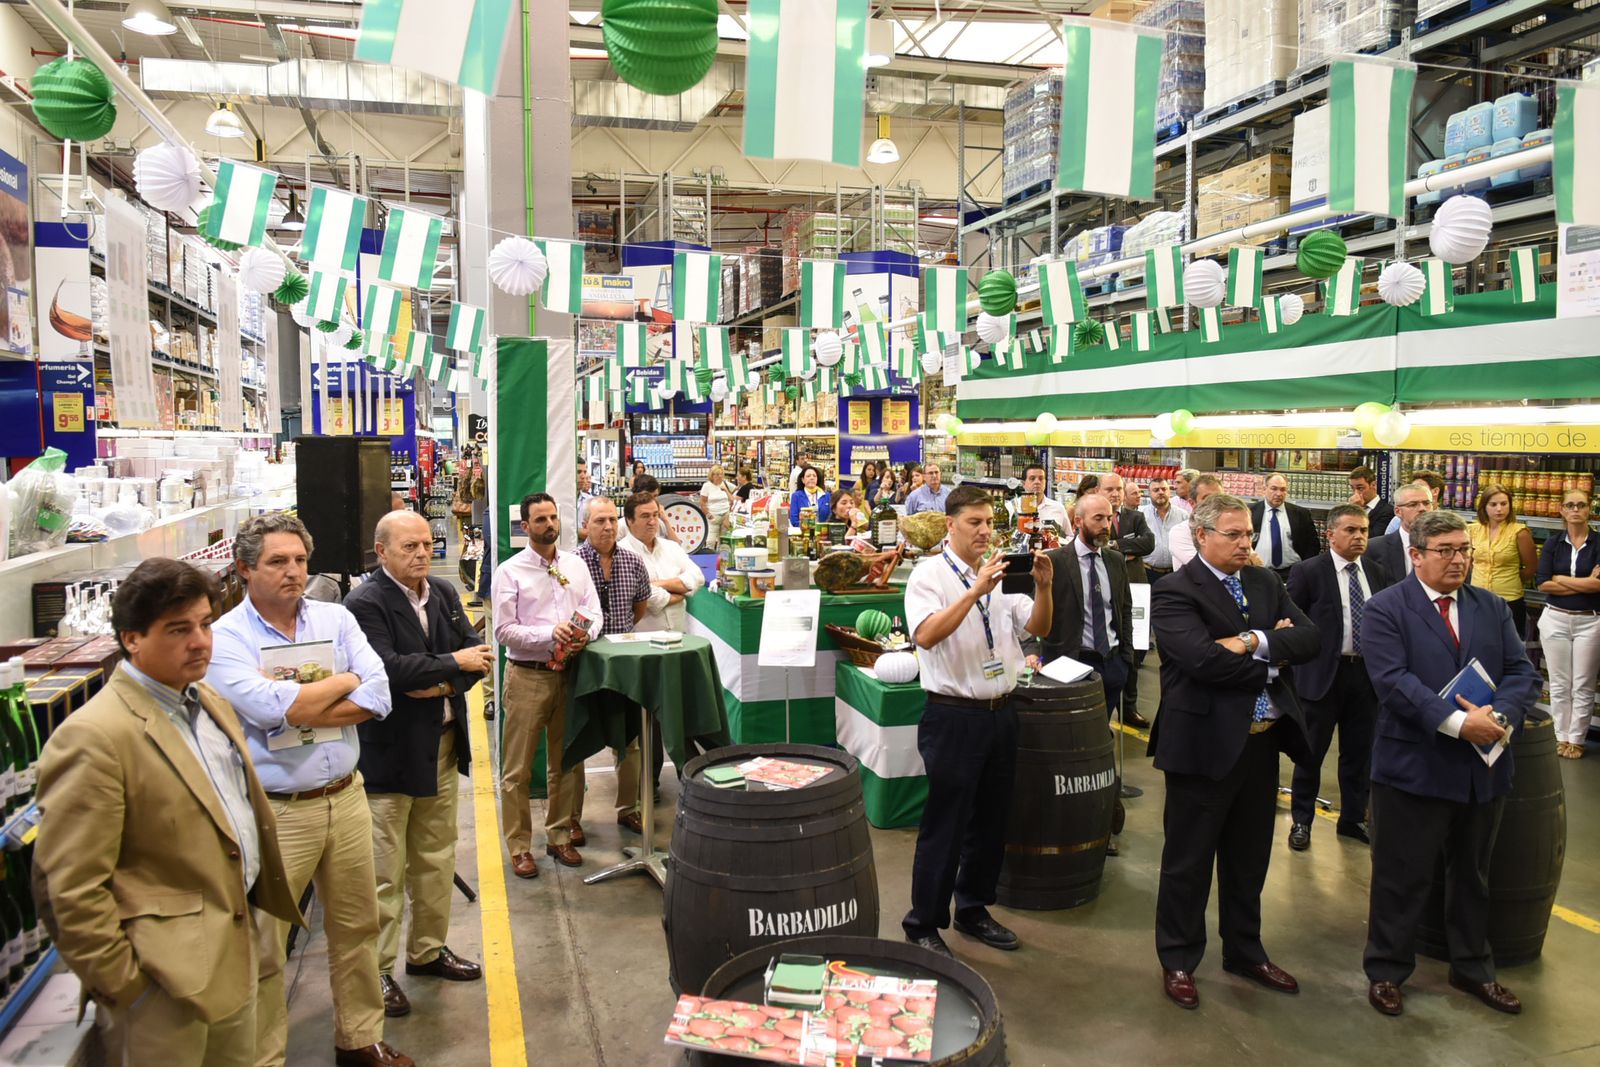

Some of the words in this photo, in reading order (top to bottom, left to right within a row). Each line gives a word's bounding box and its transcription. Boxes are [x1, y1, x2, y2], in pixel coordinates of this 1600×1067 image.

[605, 279, 631, 287] makro
[1216, 433, 1231, 445] es
[1235, 430, 1275, 447] tiempo
[1278, 430, 1296, 445] de
[1450, 431, 1473, 446] es
[1481, 427, 1549, 450] tiempo
[1557, 427, 1587, 448] de
[1380, 460, 1388, 500] omoción
[748, 898, 858, 937] BARBADILLO
